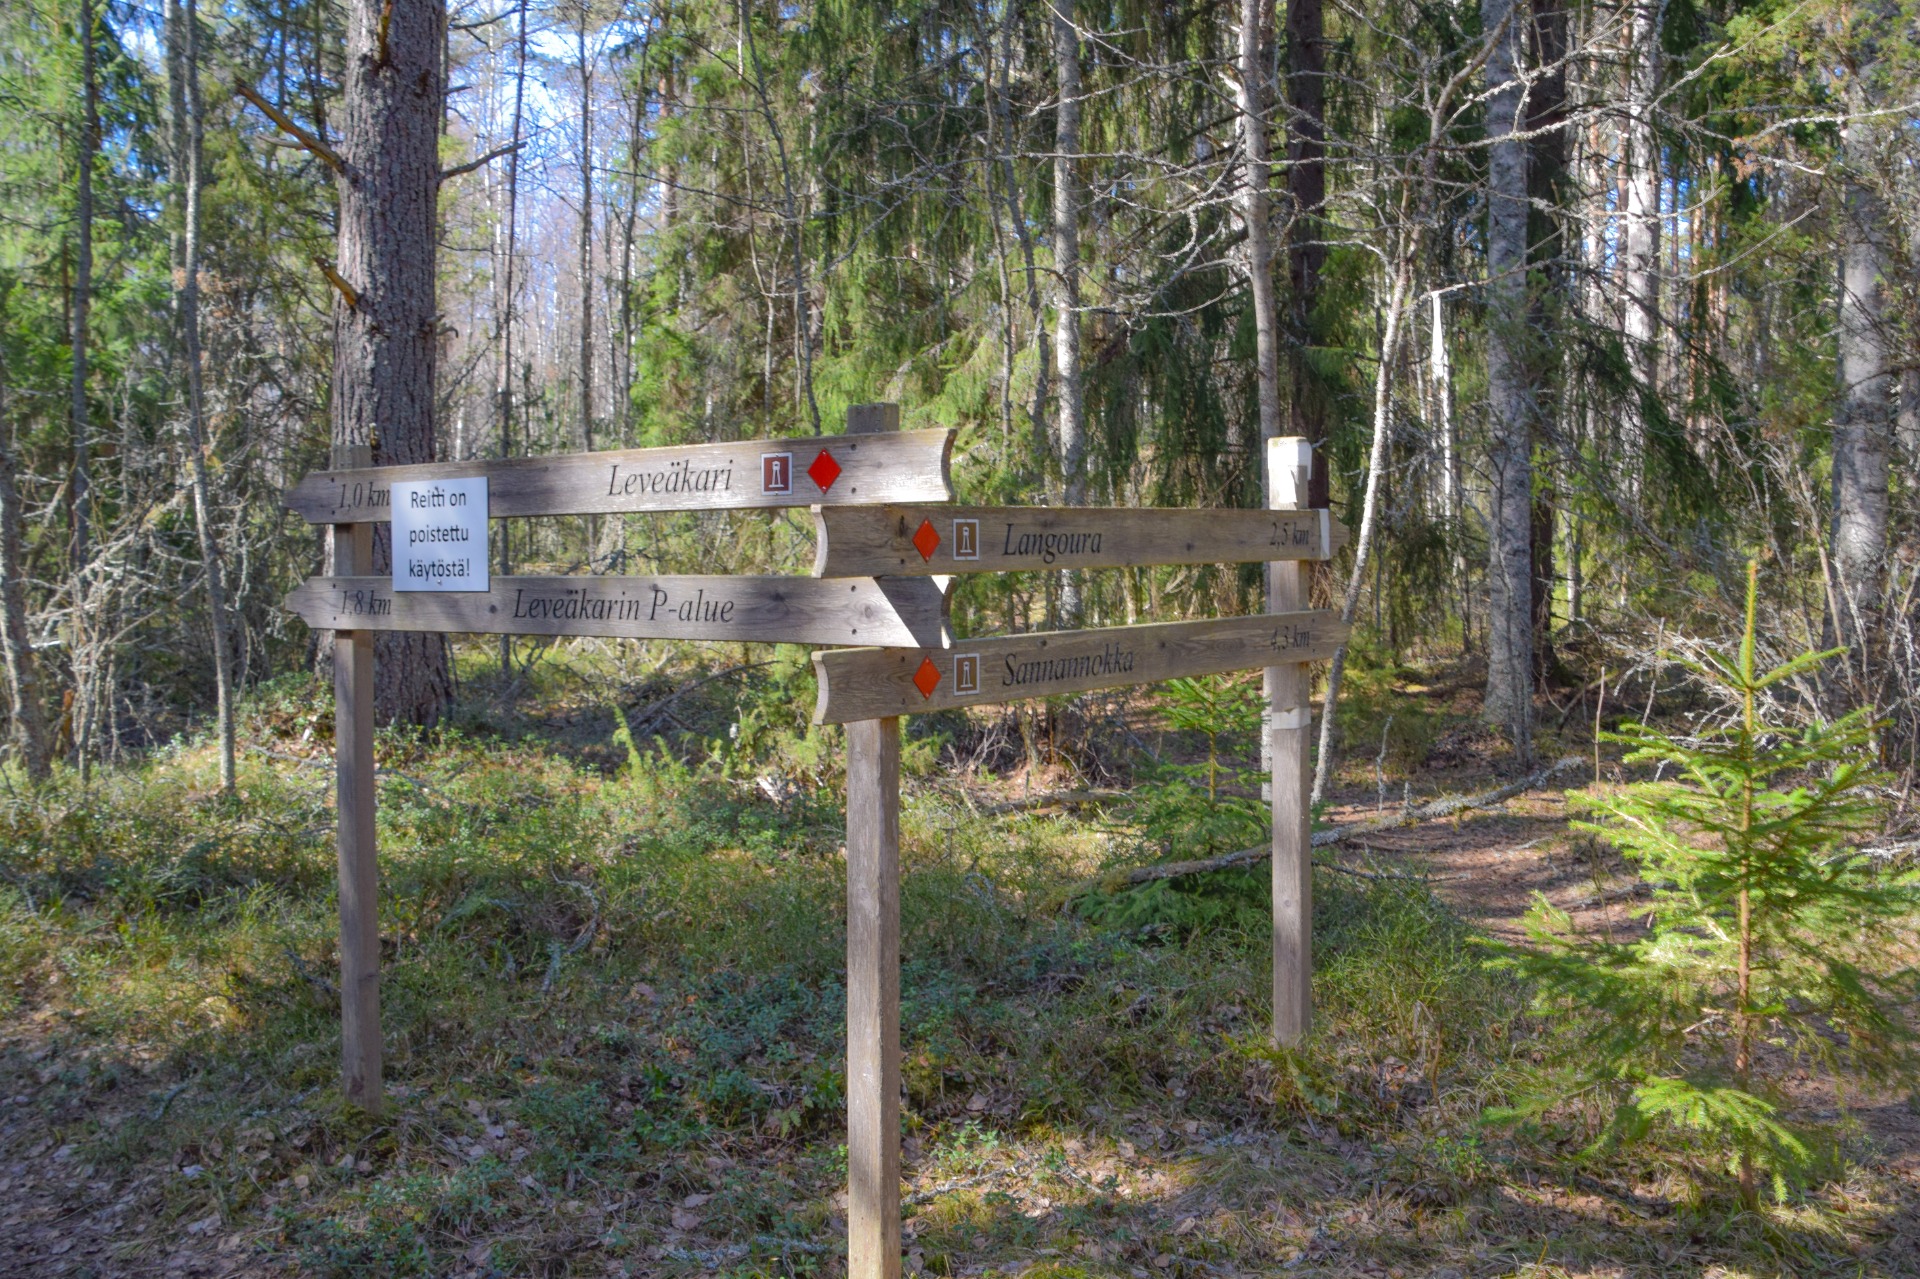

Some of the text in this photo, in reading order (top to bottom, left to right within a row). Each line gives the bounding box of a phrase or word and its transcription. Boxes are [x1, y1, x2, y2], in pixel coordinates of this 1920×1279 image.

[607, 458, 734, 497] Leveäkari
[339, 481, 391, 512] 1,0 km
[410, 487, 468, 509] Reitti on
[409, 525, 469, 548] poistettu
[1002, 523, 1103, 564] Langoura
[1269, 521, 1310, 549] 2,5 km
[409, 558, 471, 582] käytöstä!
[340, 589, 391, 616] 1,8 km
[513, 588, 735, 624] Leveäkarin P-alue
[1270, 624, 1311, 653] 4,3 km
[1002, 642, 1135, 688] Sannannokka
